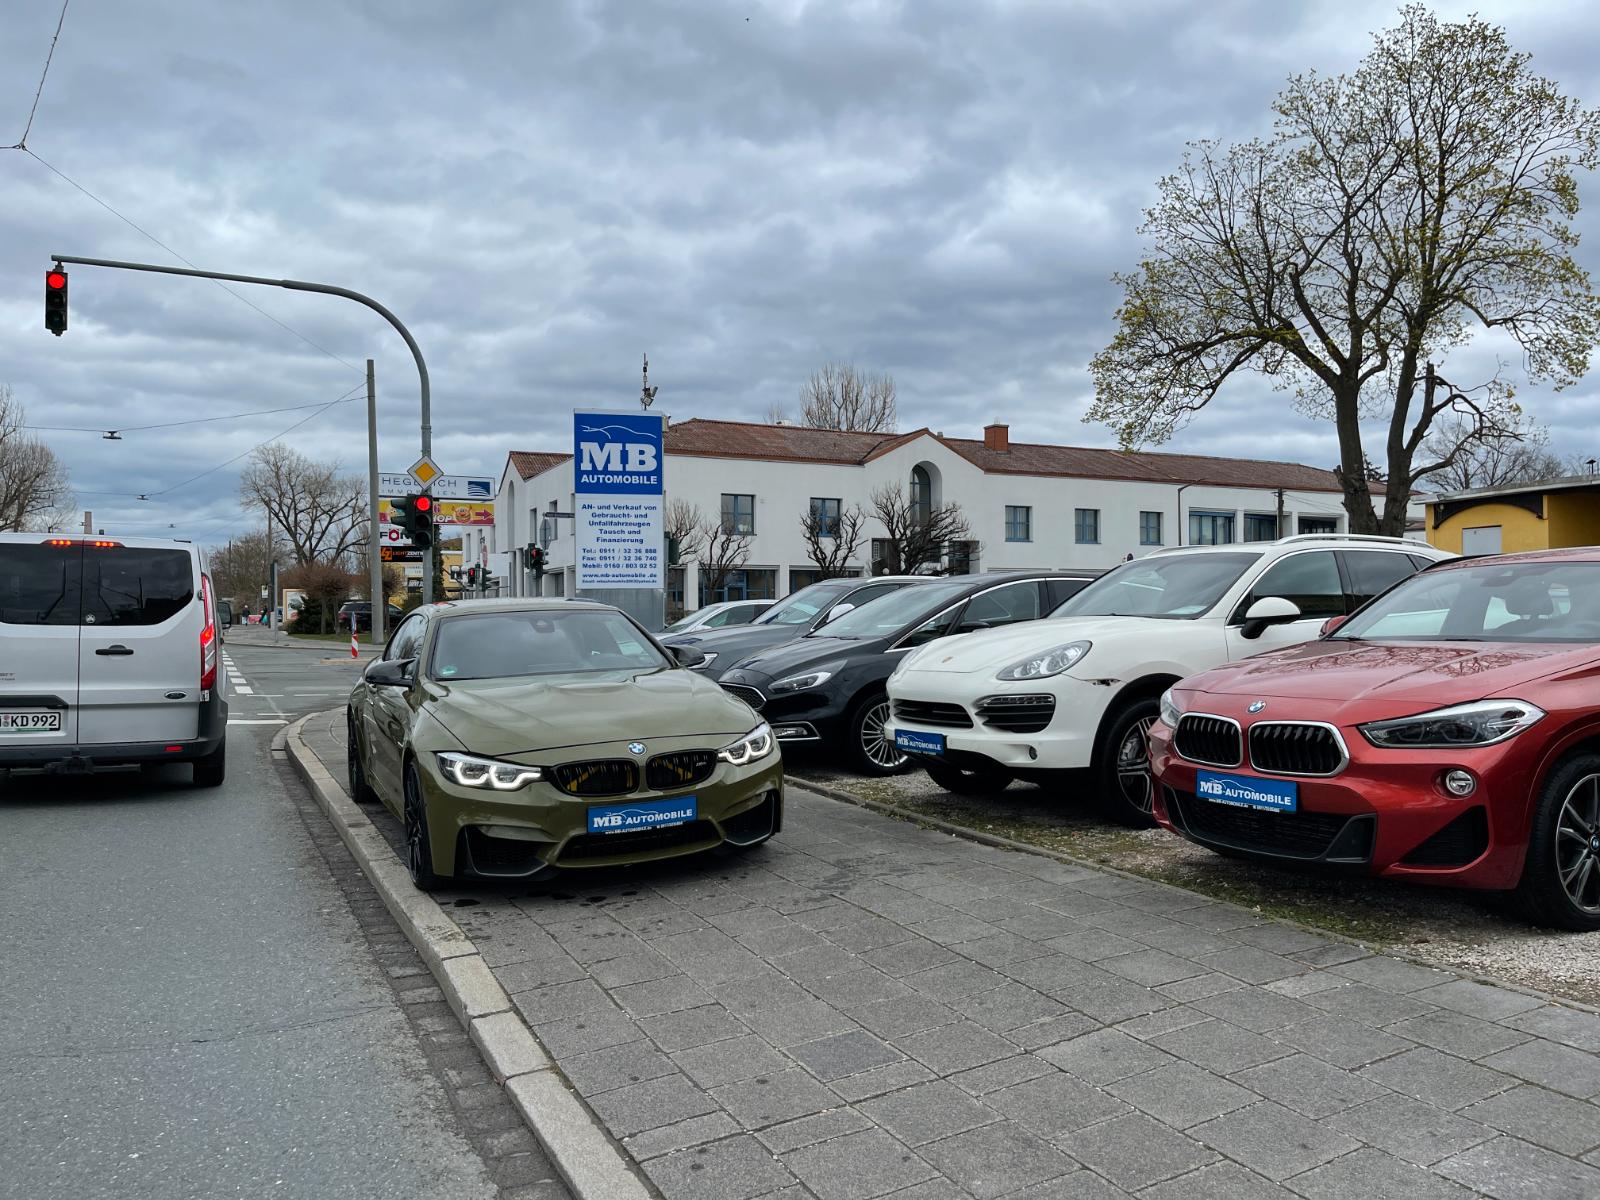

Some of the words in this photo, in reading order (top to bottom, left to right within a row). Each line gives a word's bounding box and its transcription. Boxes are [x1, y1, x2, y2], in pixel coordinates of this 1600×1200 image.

[580, 441, 658, 472] MB
[581, 474, 658, 484] AUTOMOBILE
[588, 520, 651, 528] Unfallfahrzeugen
[596, 536, 644, 544] Finanzierung
[10, 715, 29, 727] KD
[31, 715, 57, 727] 992
[1200, 781, 1292, 805] MB-AUTOMOBILE
[593, 808, 693, 828] MB-AUTOMOBILE
